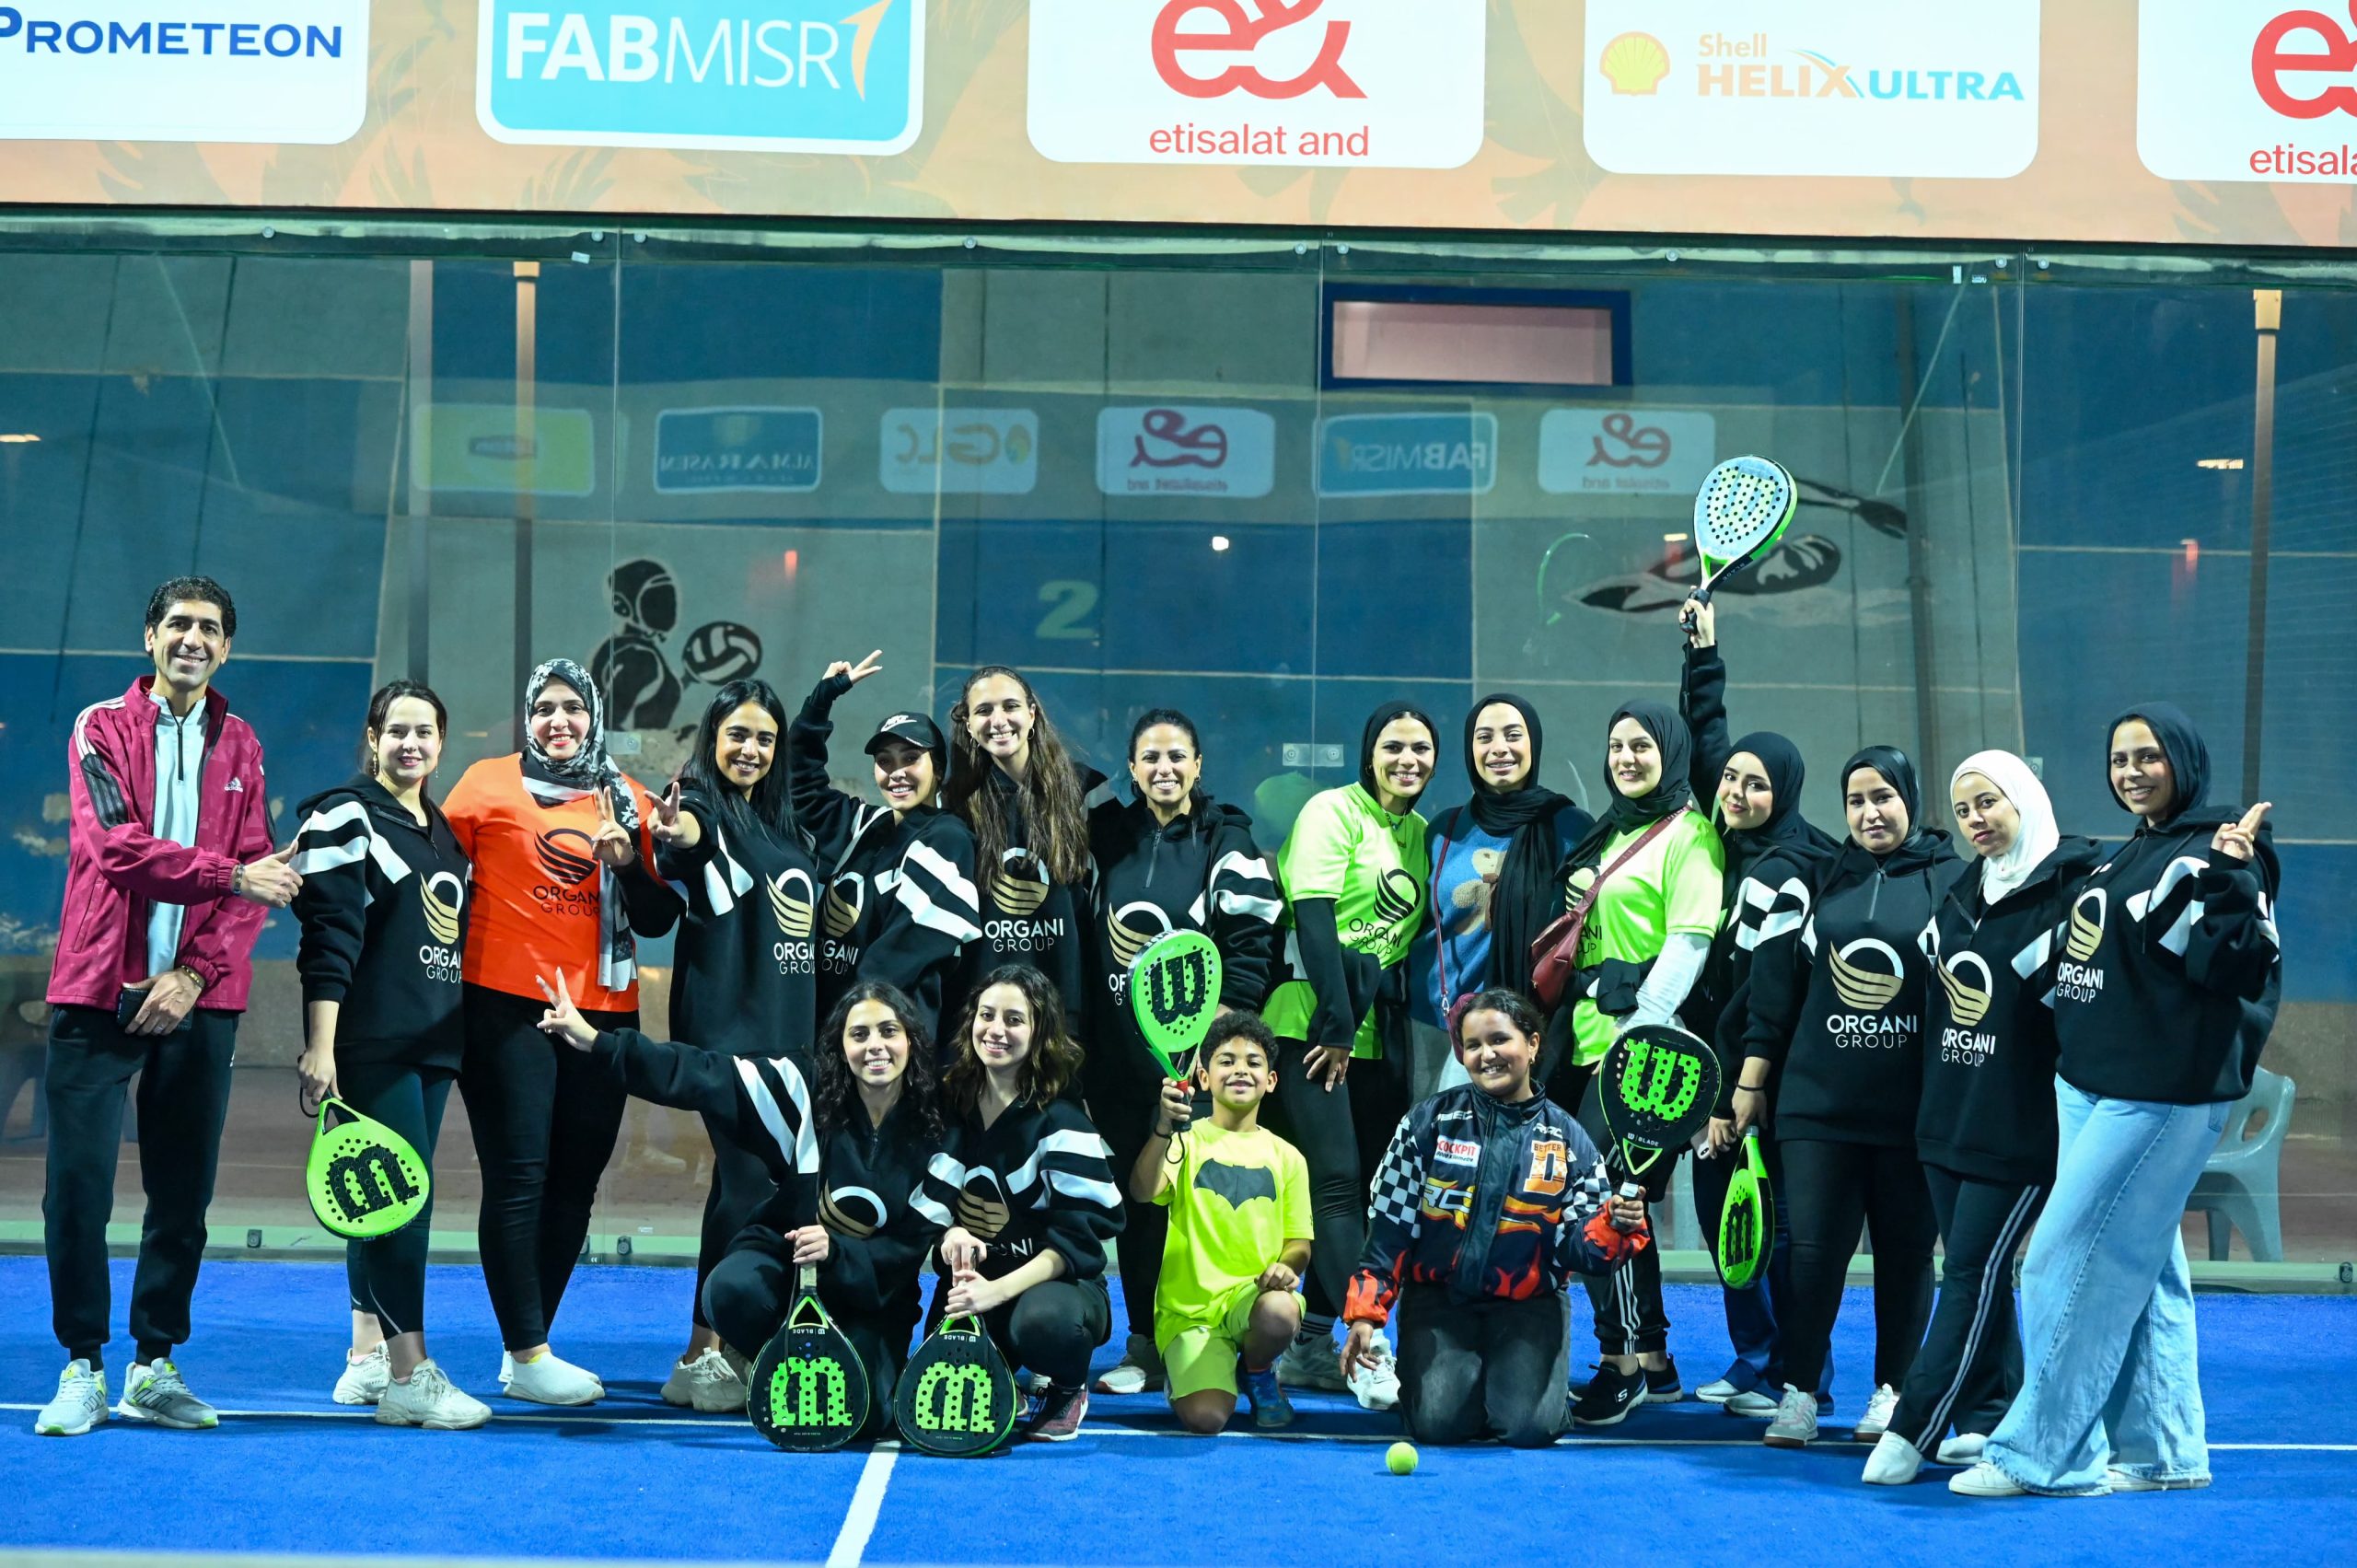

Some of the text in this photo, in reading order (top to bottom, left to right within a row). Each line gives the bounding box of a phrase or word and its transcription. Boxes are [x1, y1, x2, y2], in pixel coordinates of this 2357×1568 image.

[0, 6, 342, 58] PROMETEON
[1698, 33, 1767, 59] Shell
[1698, 64, 2025, 100] HELIX ULTRA
[1149, 122, 1369, 157] etisalat and
[1037, 580, 1099, 640] 2
[533, 885, 601, 904] ORGAN
[984, 918, 1064, 939] ORGANI
[993, 937, 1055, 953] GROUP
[2057, 961, 2104, 990] ORGANI
[2056, 981, 2096, 1004] GROUP
[1827, 1015, 1918, 1034] ORGANI
[1835, 1034, 1909, 1049] GROUP
[1942, 1028, 1996, 1055] ORGANI
[1941, 1047, 1985, 1068] GROUP
[1438, 1140, 1476, 1156] COCKPIT
[1534, 1143, 1562, 1153] BETTER
[1638, 1136, 1659, 1147] BLADE
[944, 1334, 965, 1342] BLADE
